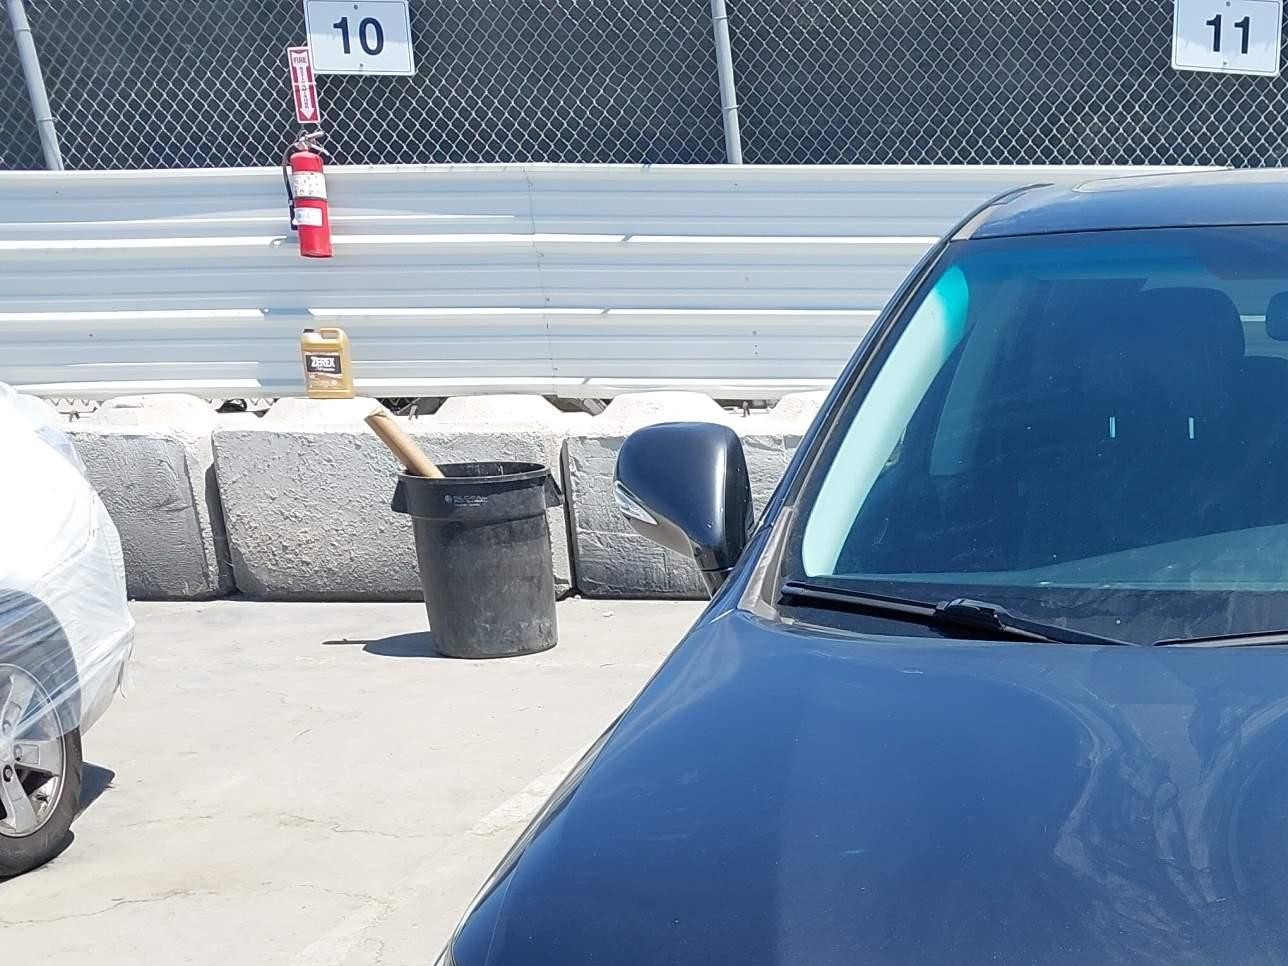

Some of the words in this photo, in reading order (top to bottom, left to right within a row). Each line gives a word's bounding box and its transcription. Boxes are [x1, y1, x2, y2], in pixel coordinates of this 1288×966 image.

[333, 17, 383, 55] 10
[1207, 15, 1249, 53] 11
[310, 356, 335, 368] ZEREX
